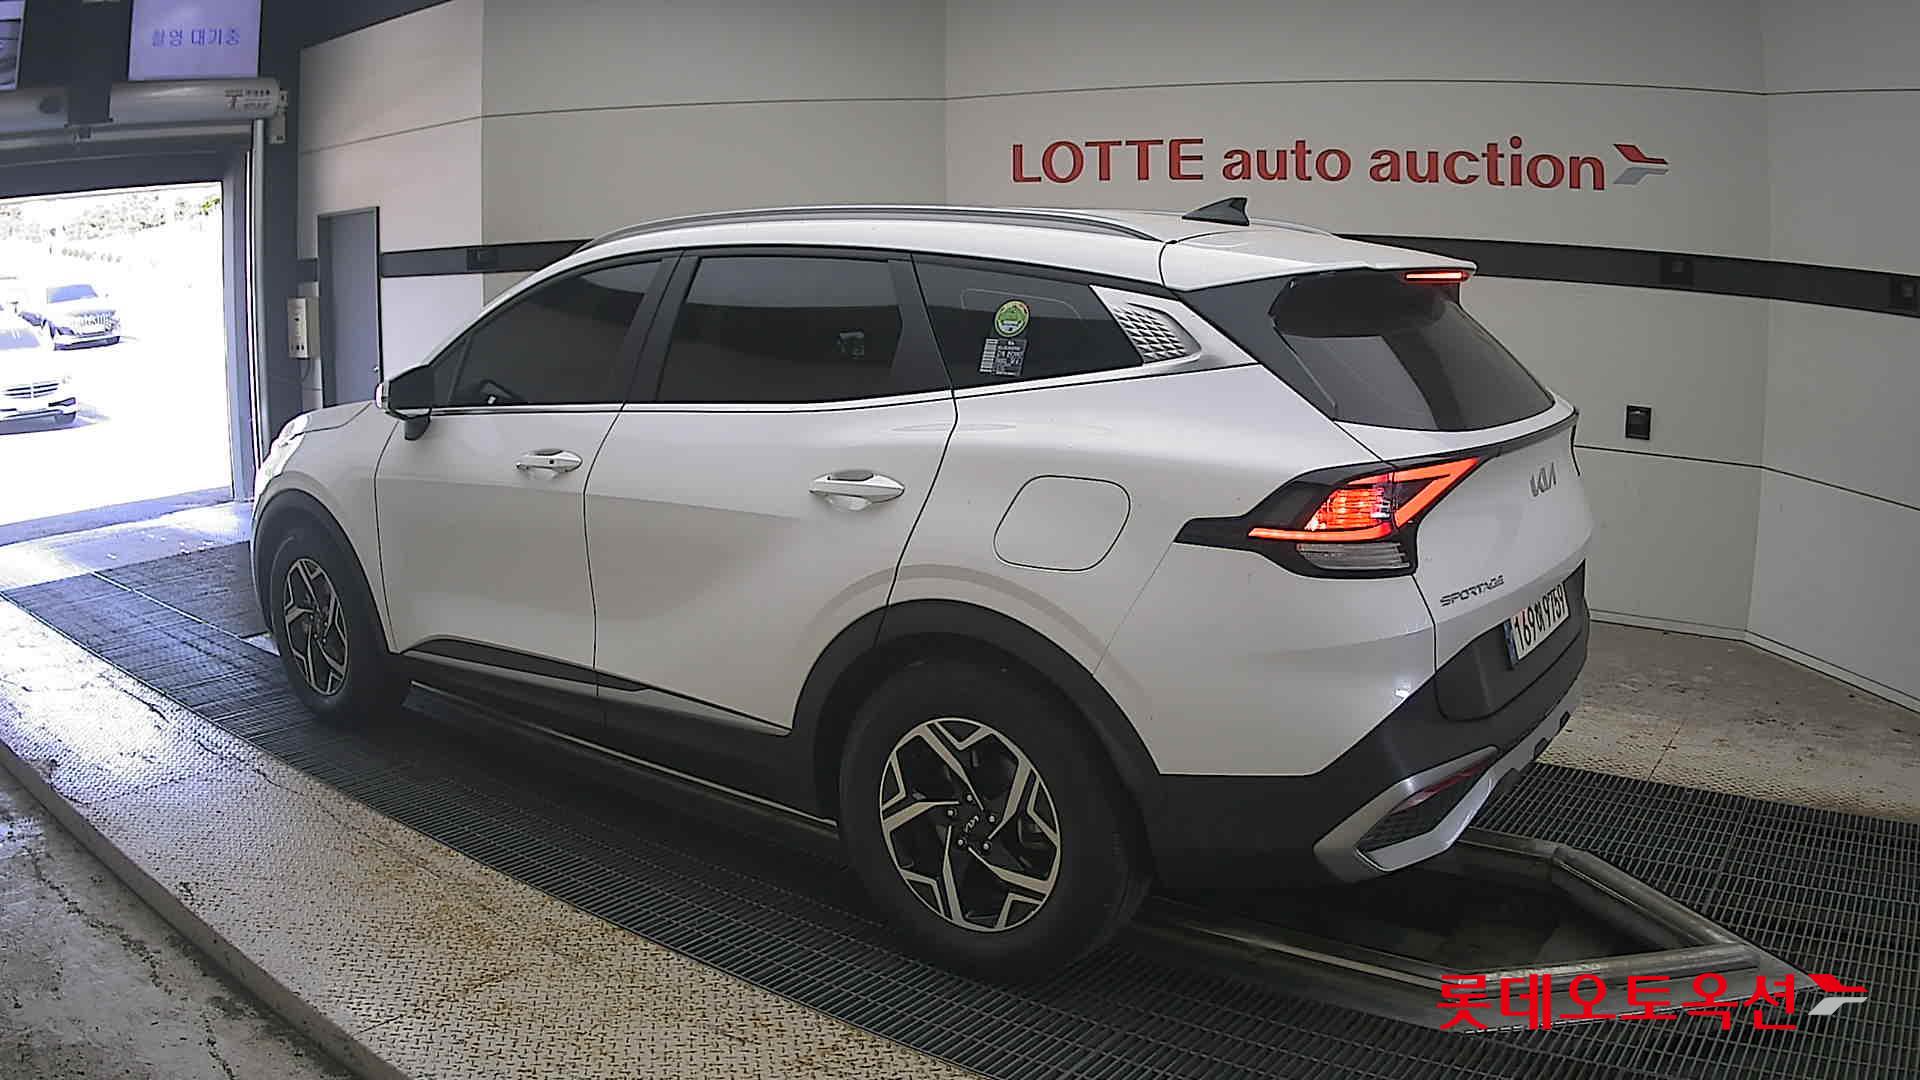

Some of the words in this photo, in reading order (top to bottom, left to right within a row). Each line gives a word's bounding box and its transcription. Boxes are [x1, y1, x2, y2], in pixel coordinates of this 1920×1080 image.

[1012, 138, 1203, 183] LOTTE
[1223, 141, 1352, 182] auto
[1369, 136, 1605, 190] auction
[1530, 461, 1557, 497] KIA
[1440, 574, 1504, 607] SPORTAGE
